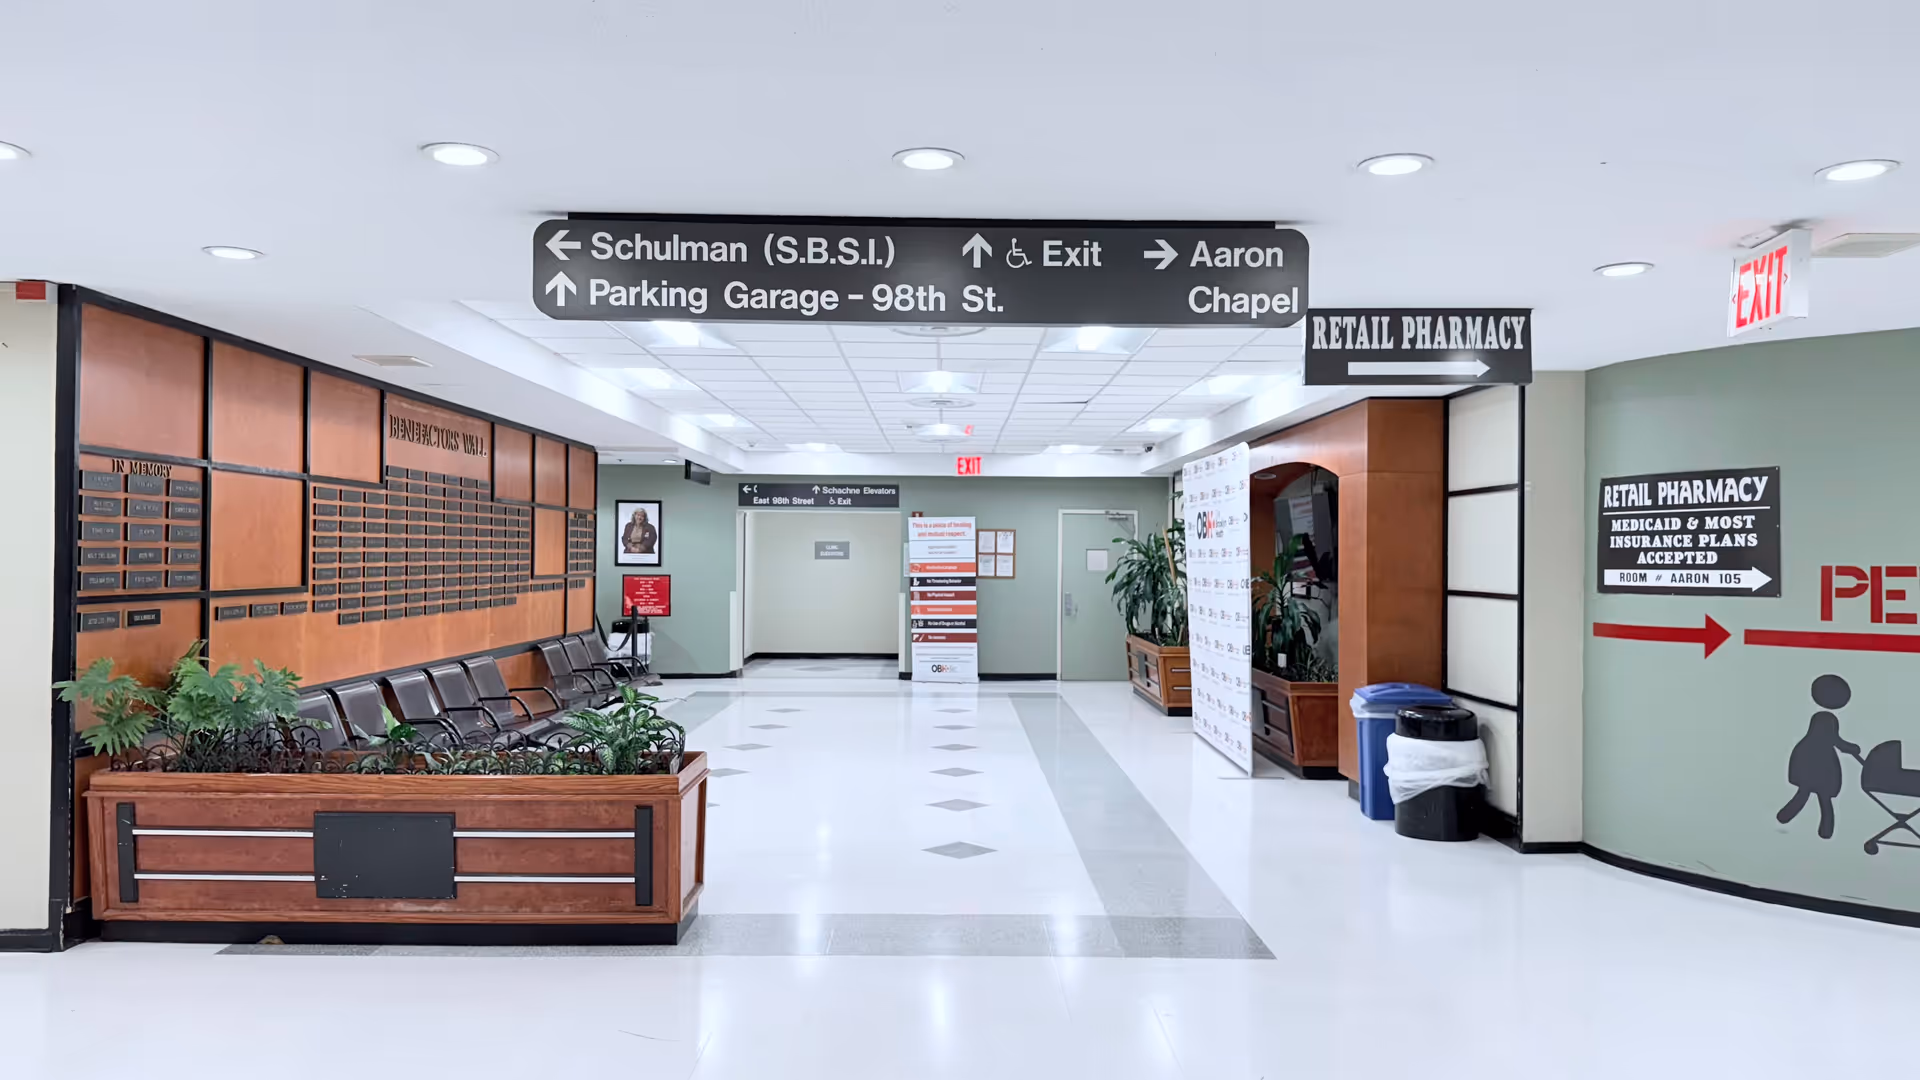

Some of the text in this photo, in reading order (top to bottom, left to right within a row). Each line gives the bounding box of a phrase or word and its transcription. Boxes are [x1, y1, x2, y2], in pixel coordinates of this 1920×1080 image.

[590, 231, 895, 269] Schulman (S.B.S.I.)
[1042, 240, 1102, 267] Exit
[1189, 240, 1284, 268] Aaron
[590, 278, 708, 314] Parking
[723, 280, 840, 317] Garage
[871, 283, 946, 312] 98th
[961, 284, 1004, 313] St.
[1736, 245, 1788, 328] EXIT
[1188, 285, 1299, 319] Chapel
[1312, 315, 1525, 350] RETAIL PHARMACY
[389, 414, 488, 457] BENEFACTORS WALL
[112, 458, 172, 478] IN MEMORY
[956, 456, 982, 475] EXIT
[753, 496, 815, 505] East 98th Street
[822, 486, 896, 495] Schachne Elevators
[837, 497, 852, 506] Exit
[1603, 475, 1769, 508] RETAIL PHARMACY
[1611, 515, 1756, 532] MEDICAID & MOST
[1609, 533, 1758, 549] INSURANCE PLANS
[1636, 551, 1718, 565] ACCEPTED
[1619, 572, 1648, 583] ROOM
[1670, 573, 1710, 584] AARON
[1719, 574, 1741, 584] 105
[1821, 565, 1920, 624] PE
